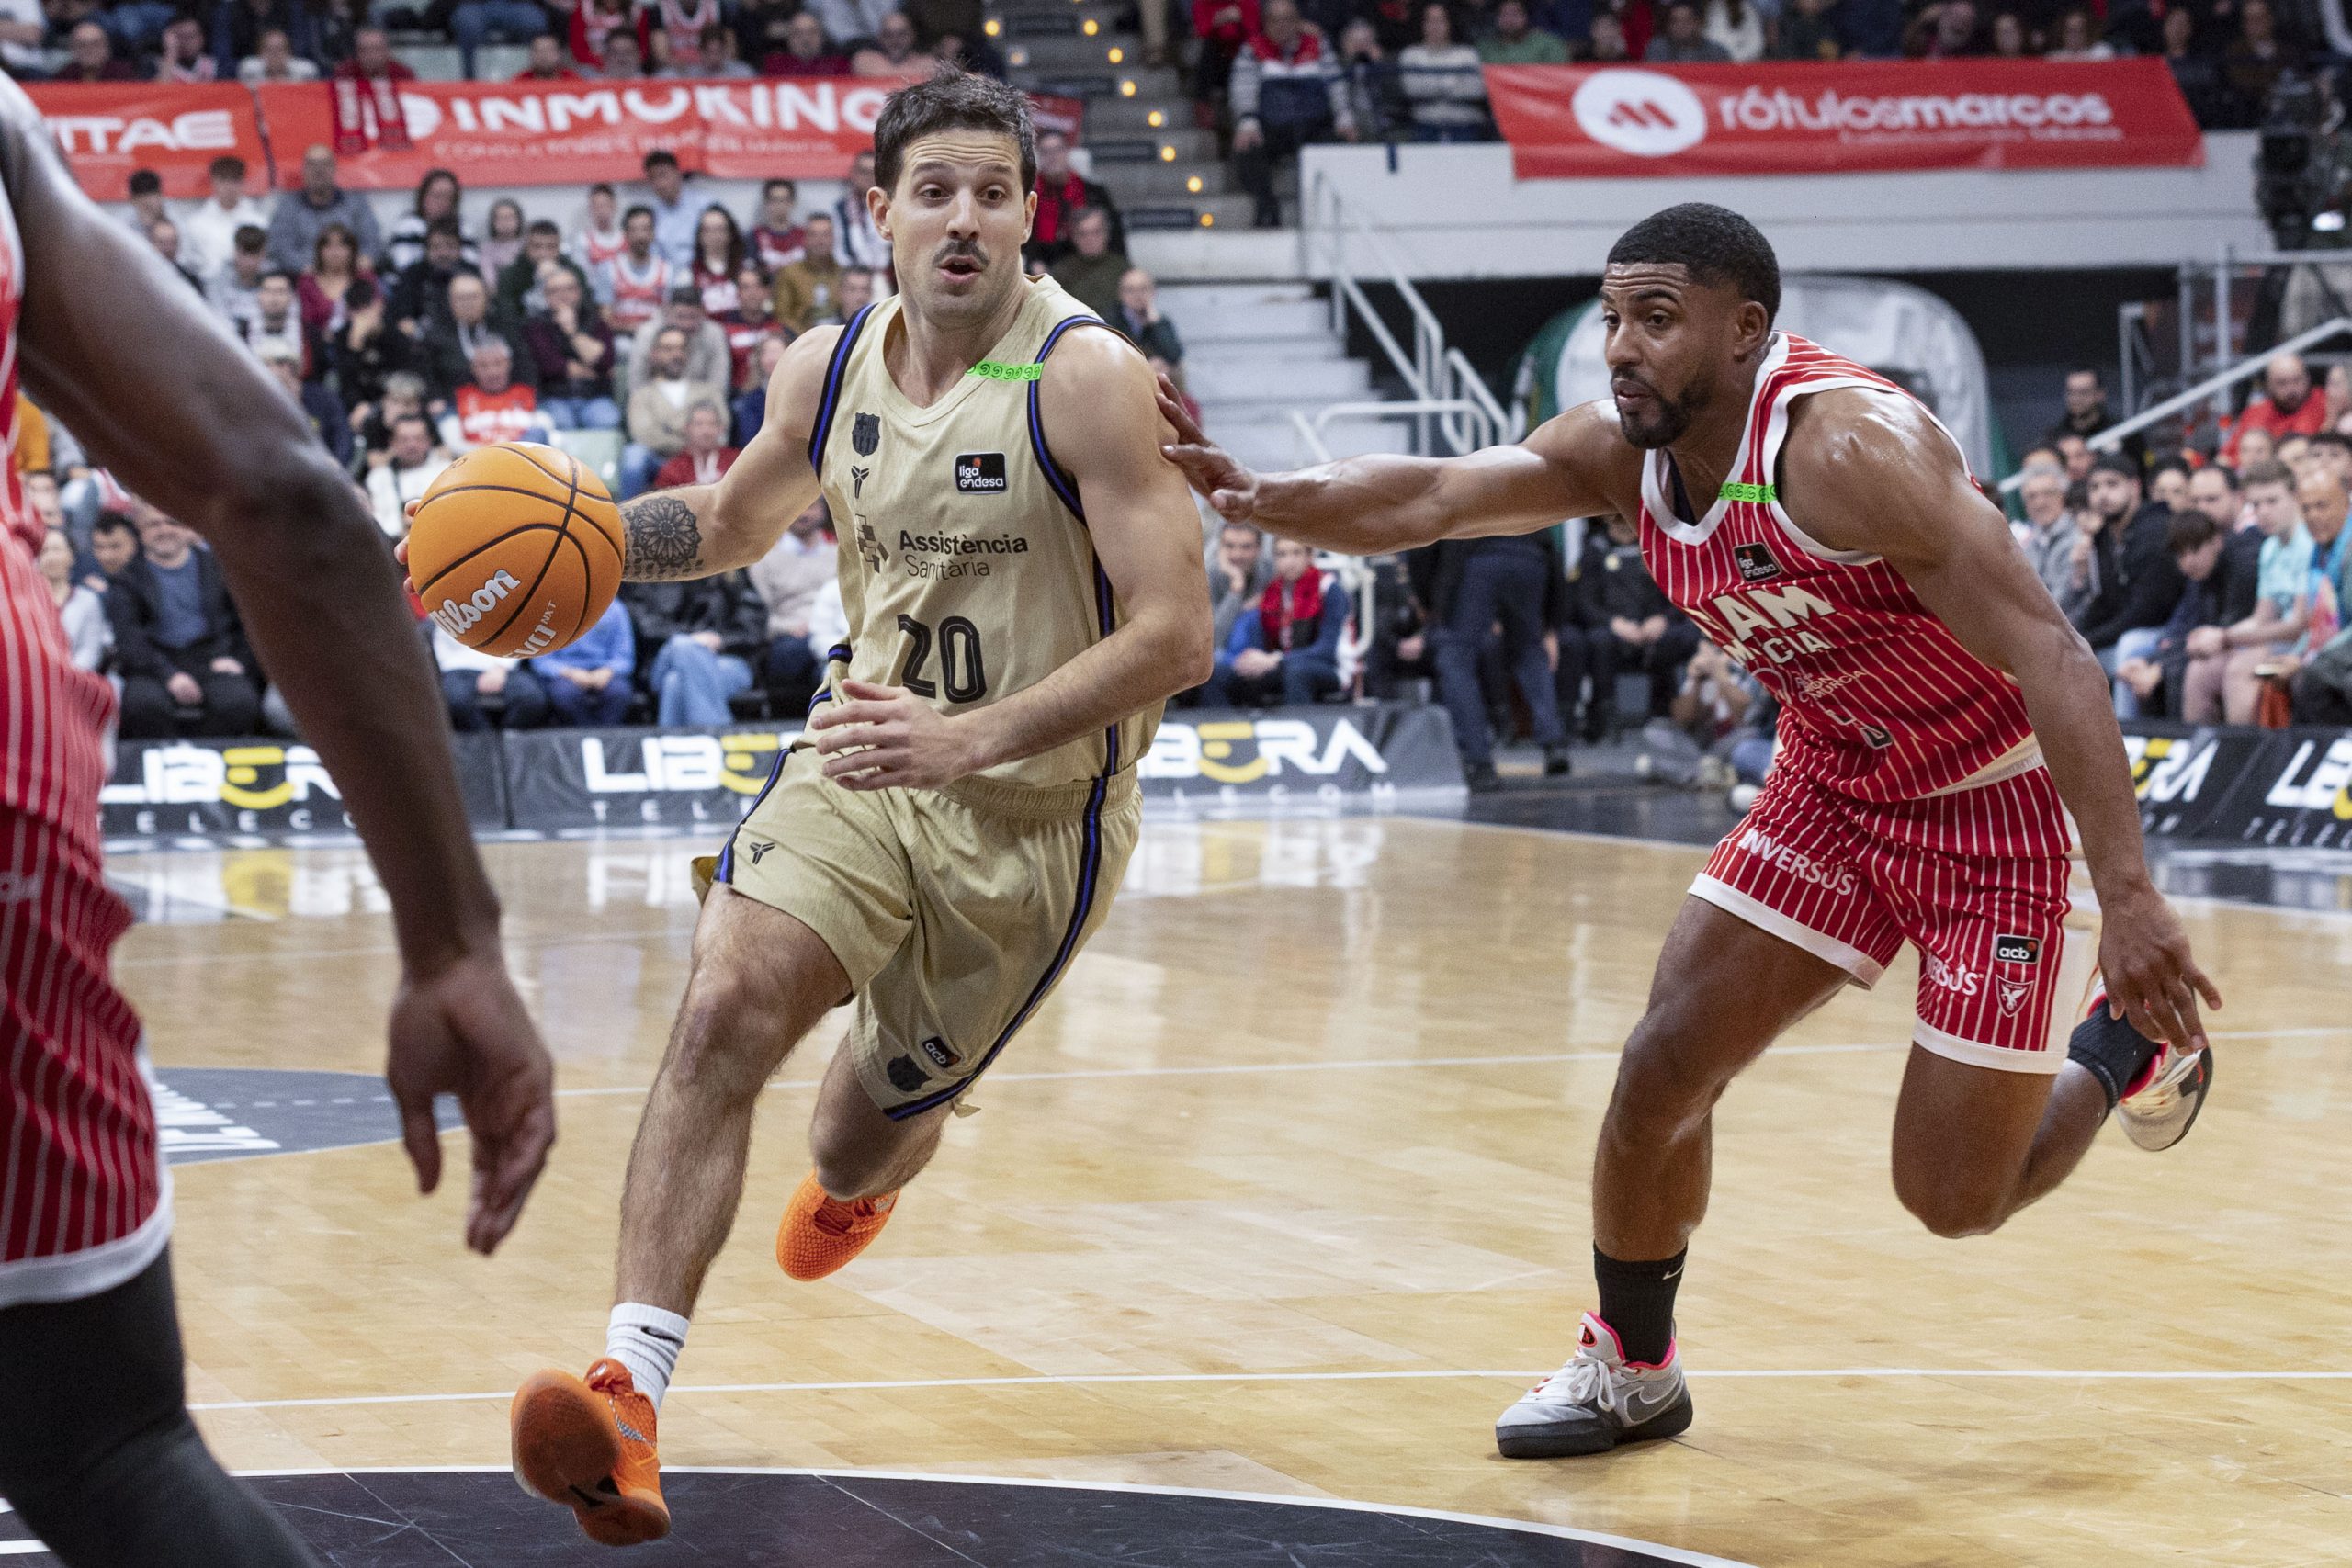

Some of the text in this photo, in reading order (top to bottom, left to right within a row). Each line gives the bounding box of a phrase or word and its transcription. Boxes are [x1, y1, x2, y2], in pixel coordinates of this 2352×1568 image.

[959, 466, 978, 478] liga
[960, 476, 1004, 488] endesa
[899, 529, 1028, 555] Assistència
[905, 554, 990, 581] Sanitària
[897, 614, 988, 704] 20
[1999, 946, 2030, 960] acb
[925, 1043, 946, 1064] acb
